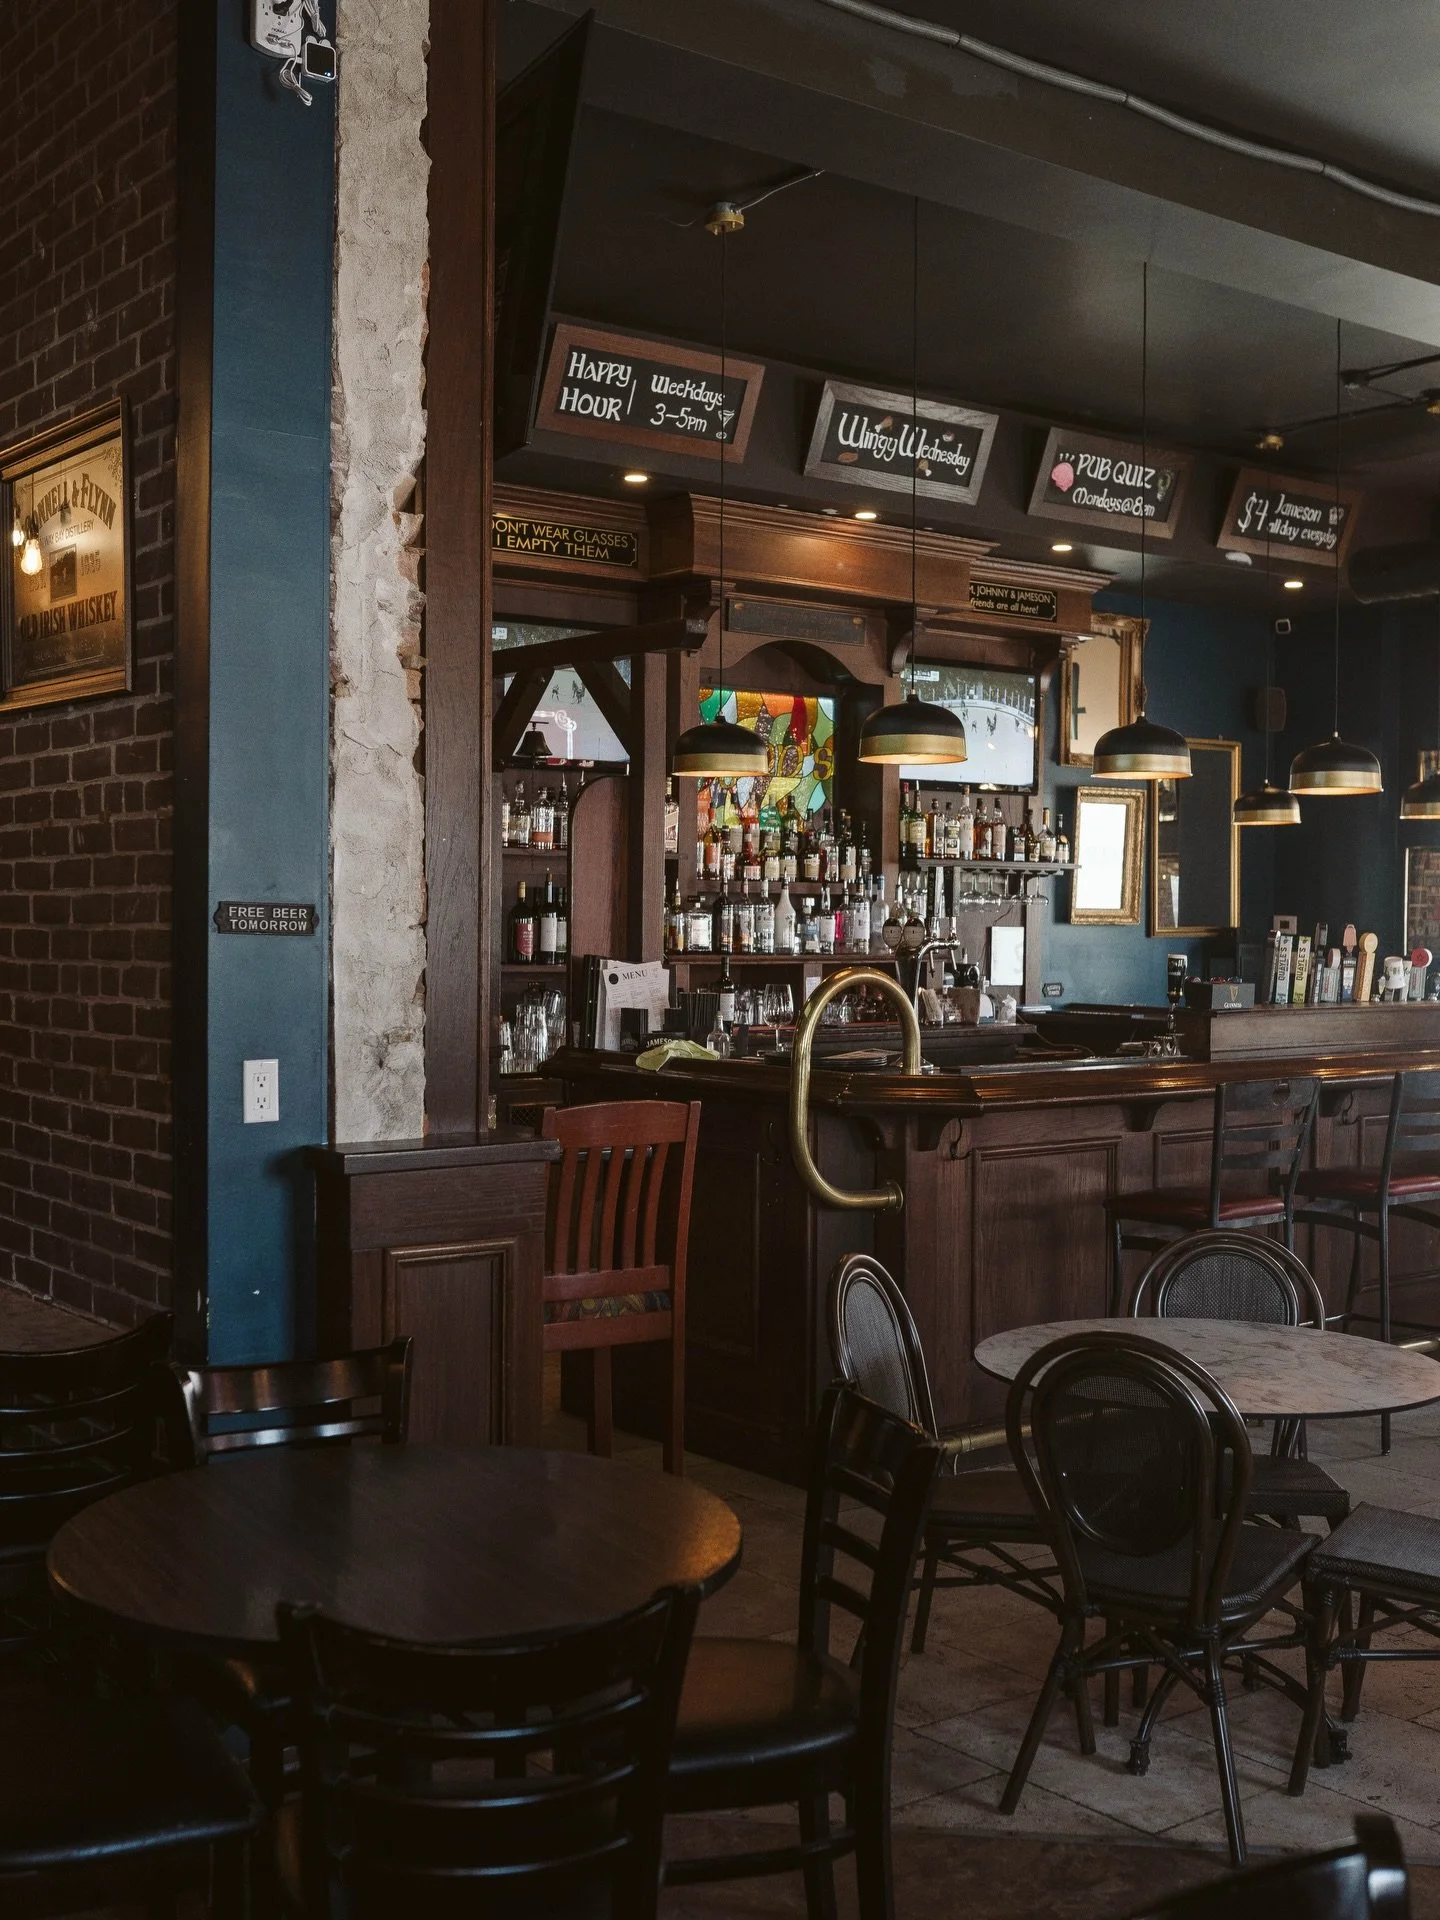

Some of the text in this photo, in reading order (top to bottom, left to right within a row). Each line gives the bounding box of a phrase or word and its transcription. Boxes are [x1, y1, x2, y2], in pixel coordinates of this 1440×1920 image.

[559, 387, 623, 422] HOUR
[838, 413, 971, 476] Wingy Wednesday
[1076, 453, 1156, 489] PUB QUIZ
[492, 519, 628, 548] ON'T WEAR GLASSES
[507, 535, 560, 552] EMPTY
[564, 542, 609, 559] THEM
[976, 586, 1009, 597] JOHNNY
[1010, 590, 1016, 599] &
[1017, 591, 1051, 603] JAMESON
[40, 604, 66, 638] IRISH
[67, 590, 118, 632] WHISKEY
[229, 906, 307, 919] FREE BEER
[229, 919, 307, 931] TOMORROW
[621, 969, 648, 980] MENU
